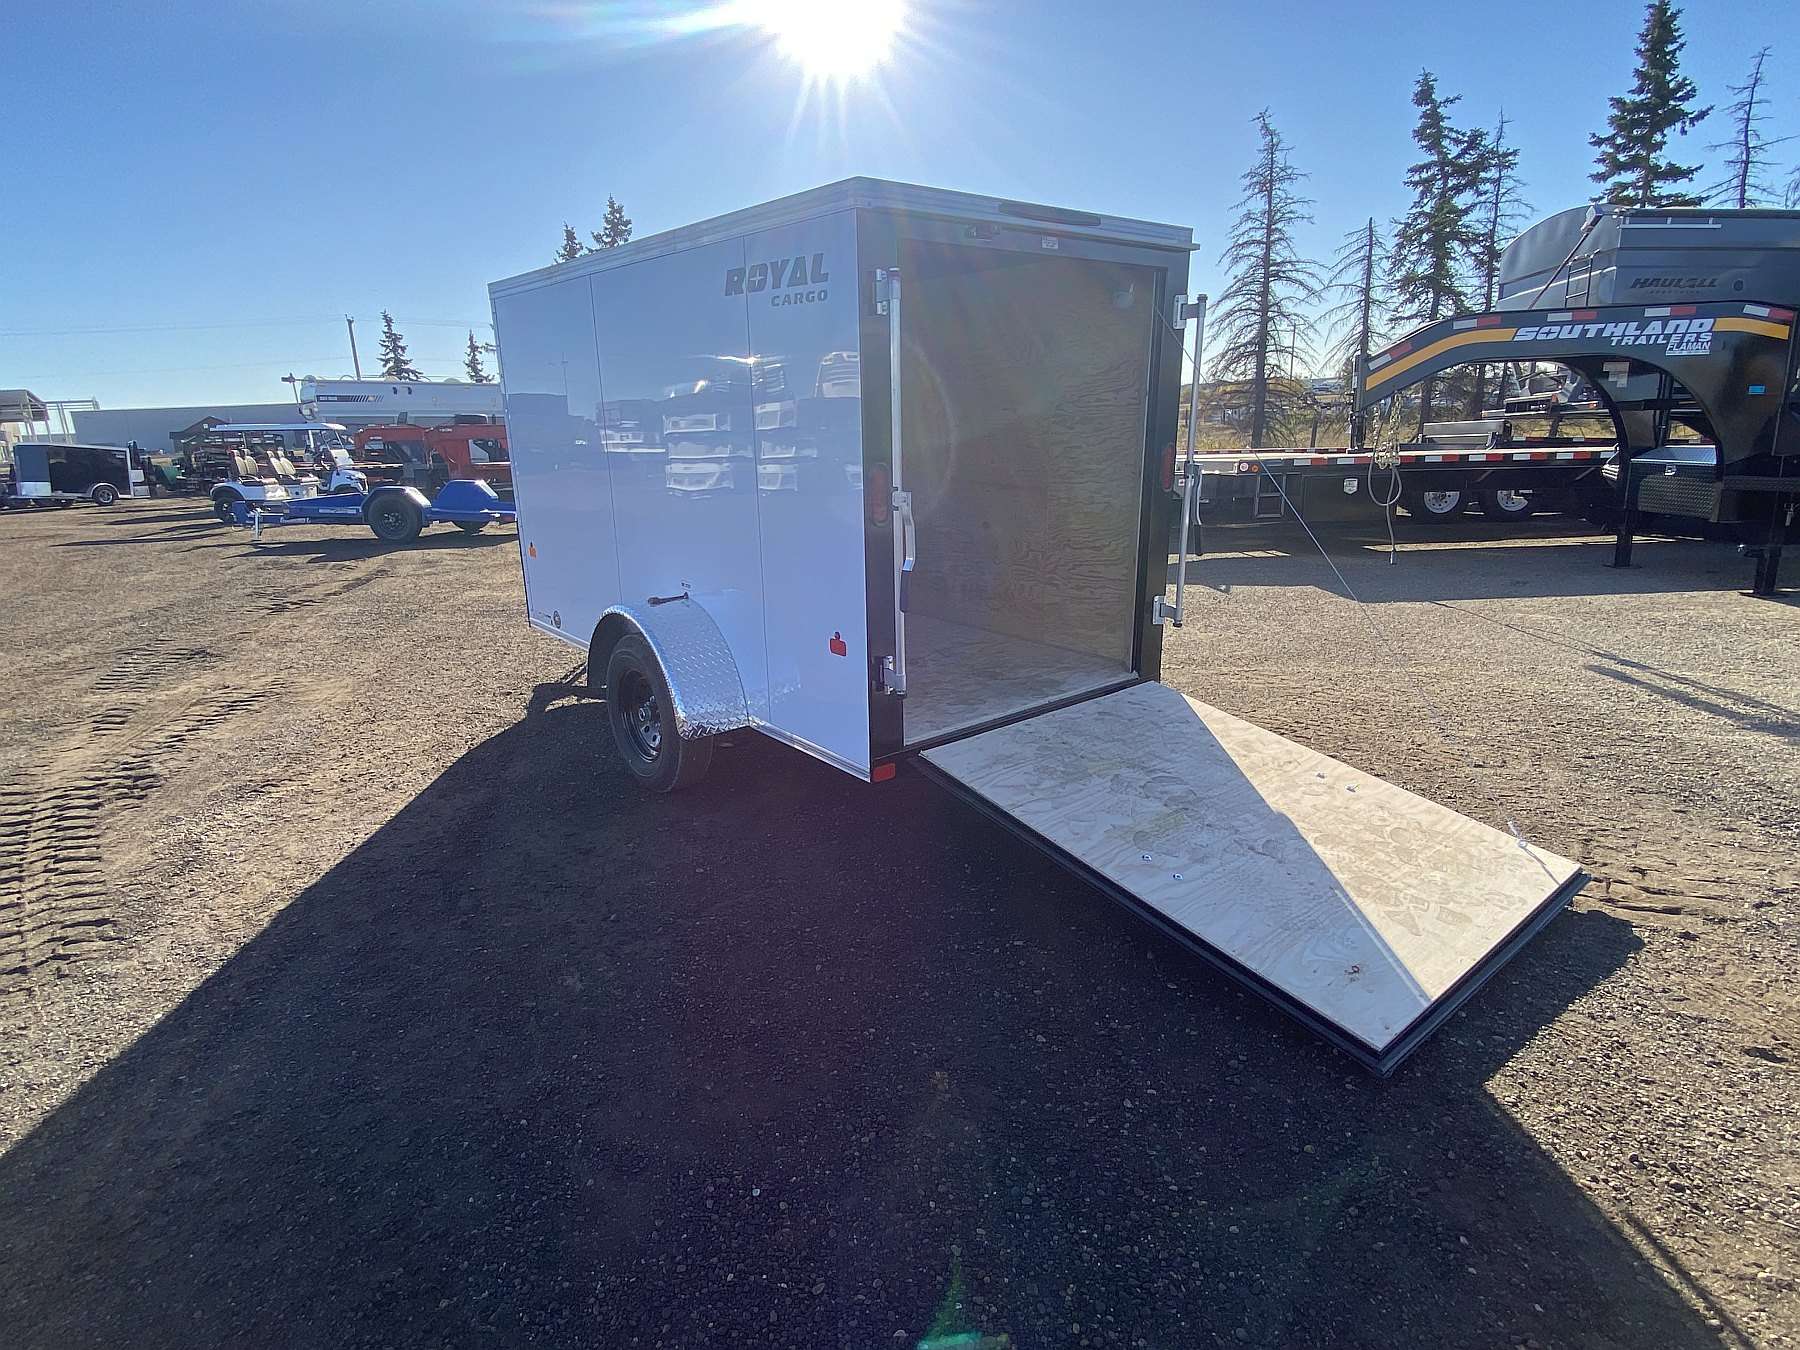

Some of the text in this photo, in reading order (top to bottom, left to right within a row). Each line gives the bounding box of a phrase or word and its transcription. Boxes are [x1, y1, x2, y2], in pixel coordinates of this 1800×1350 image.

[725, 253, 829, 296] ROYAL
[771, 289, 828, 306] CARGO
[1514, 318, 1715, 341] SOUTHLAND
[1610, 333, 1713, 346] TRAILERS
[1667, 341, 1710, 351] FLAMAN
